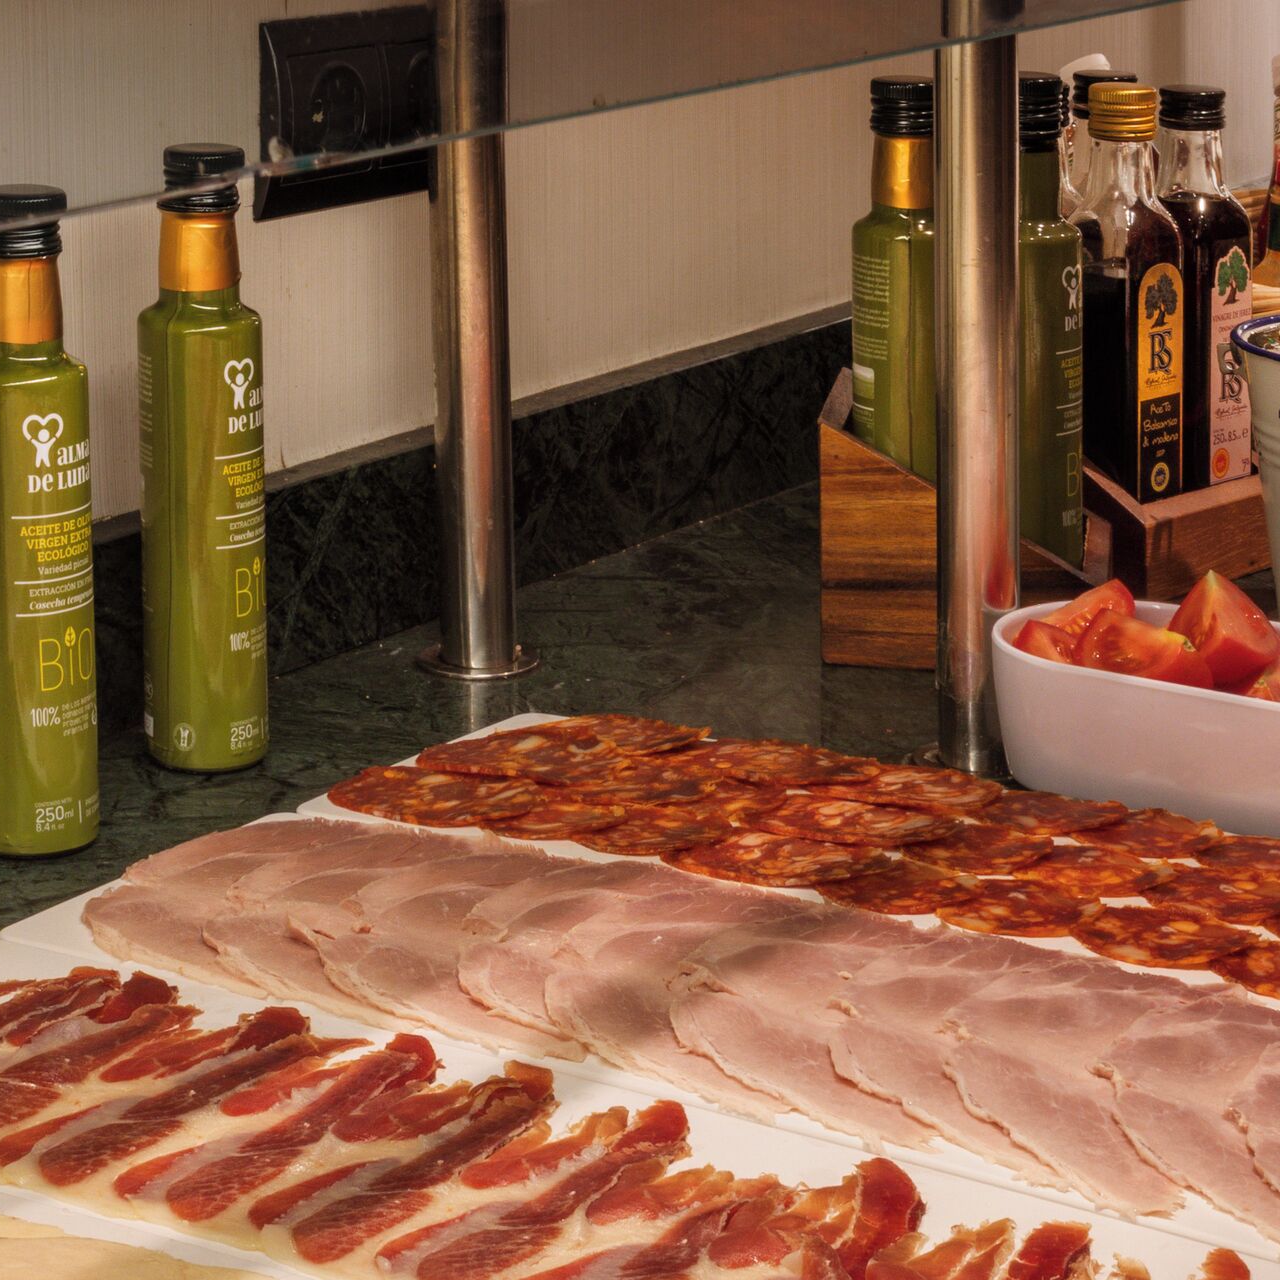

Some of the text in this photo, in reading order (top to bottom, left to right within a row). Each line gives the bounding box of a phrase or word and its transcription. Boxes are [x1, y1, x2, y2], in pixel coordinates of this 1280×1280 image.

[223, 460, 251, 475] ACEITE
[227, 470, 257, 486] VIRGEN
[20, 512, 92, 537] ACEITE DE OLIV
[26, 535, 68, 550] VIRGEN
[37, 541, 89, 563] ECOLÓGICO
[38, 561, 72, 575] Variedad
[29, 597, 66, 611] Cosecha
[30, 705, 61, 728] 100%
